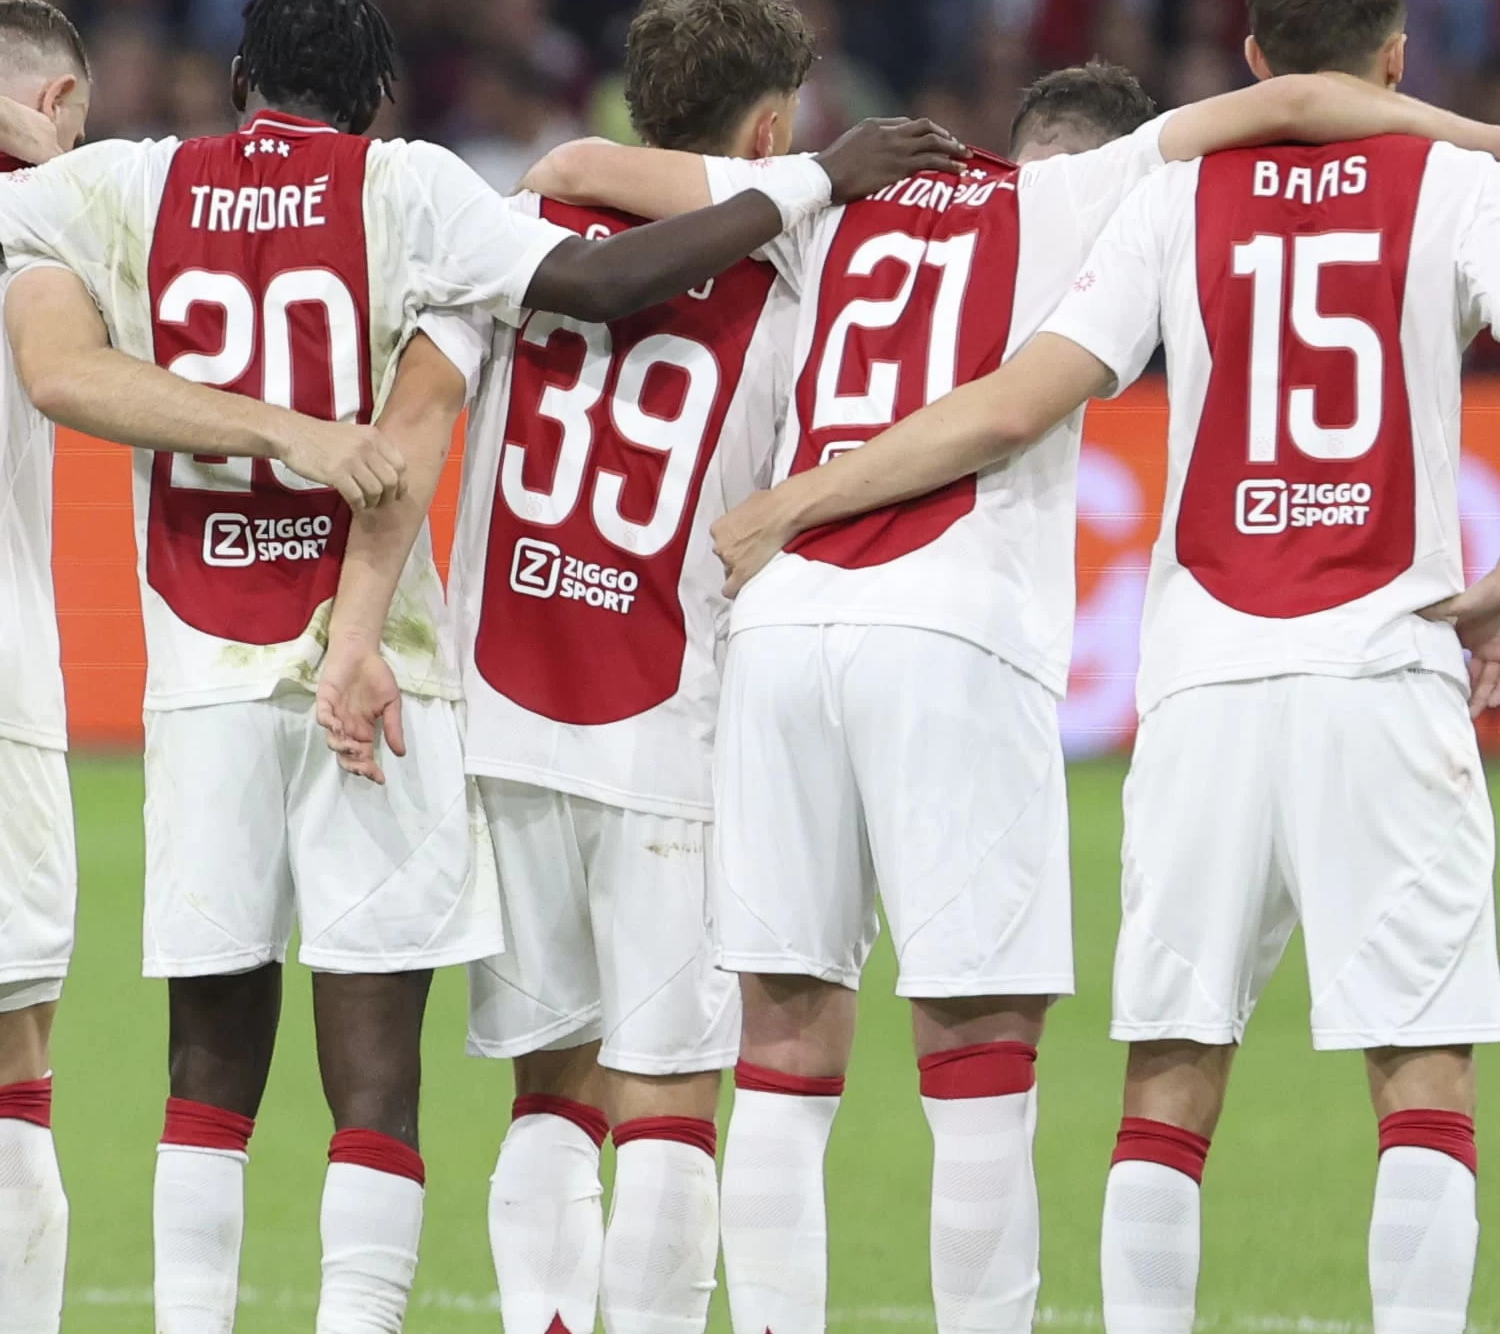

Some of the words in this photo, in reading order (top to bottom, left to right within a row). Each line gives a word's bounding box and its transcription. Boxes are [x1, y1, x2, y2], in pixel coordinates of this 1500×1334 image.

[1253, 155, 1368, 204] BAAS
[190, 174, 329, 233] TRAORÉ
[809, 229, 979, 433] 21
[1231, 229, 1383, 465] 15
[157, 267, 361, 493] 20
[500, 308, 722, 560] 39
[1290, 482, 1372, 505] ZIGGO
[254, 515, 333, 540] ZIGGO
[1289, 504, 1370, 528] SPORT
[258, 539, 328, 562] SPORT
[563, 555, 639, 593] ZIGGO
[559, 581, 635, 615] SPORT
